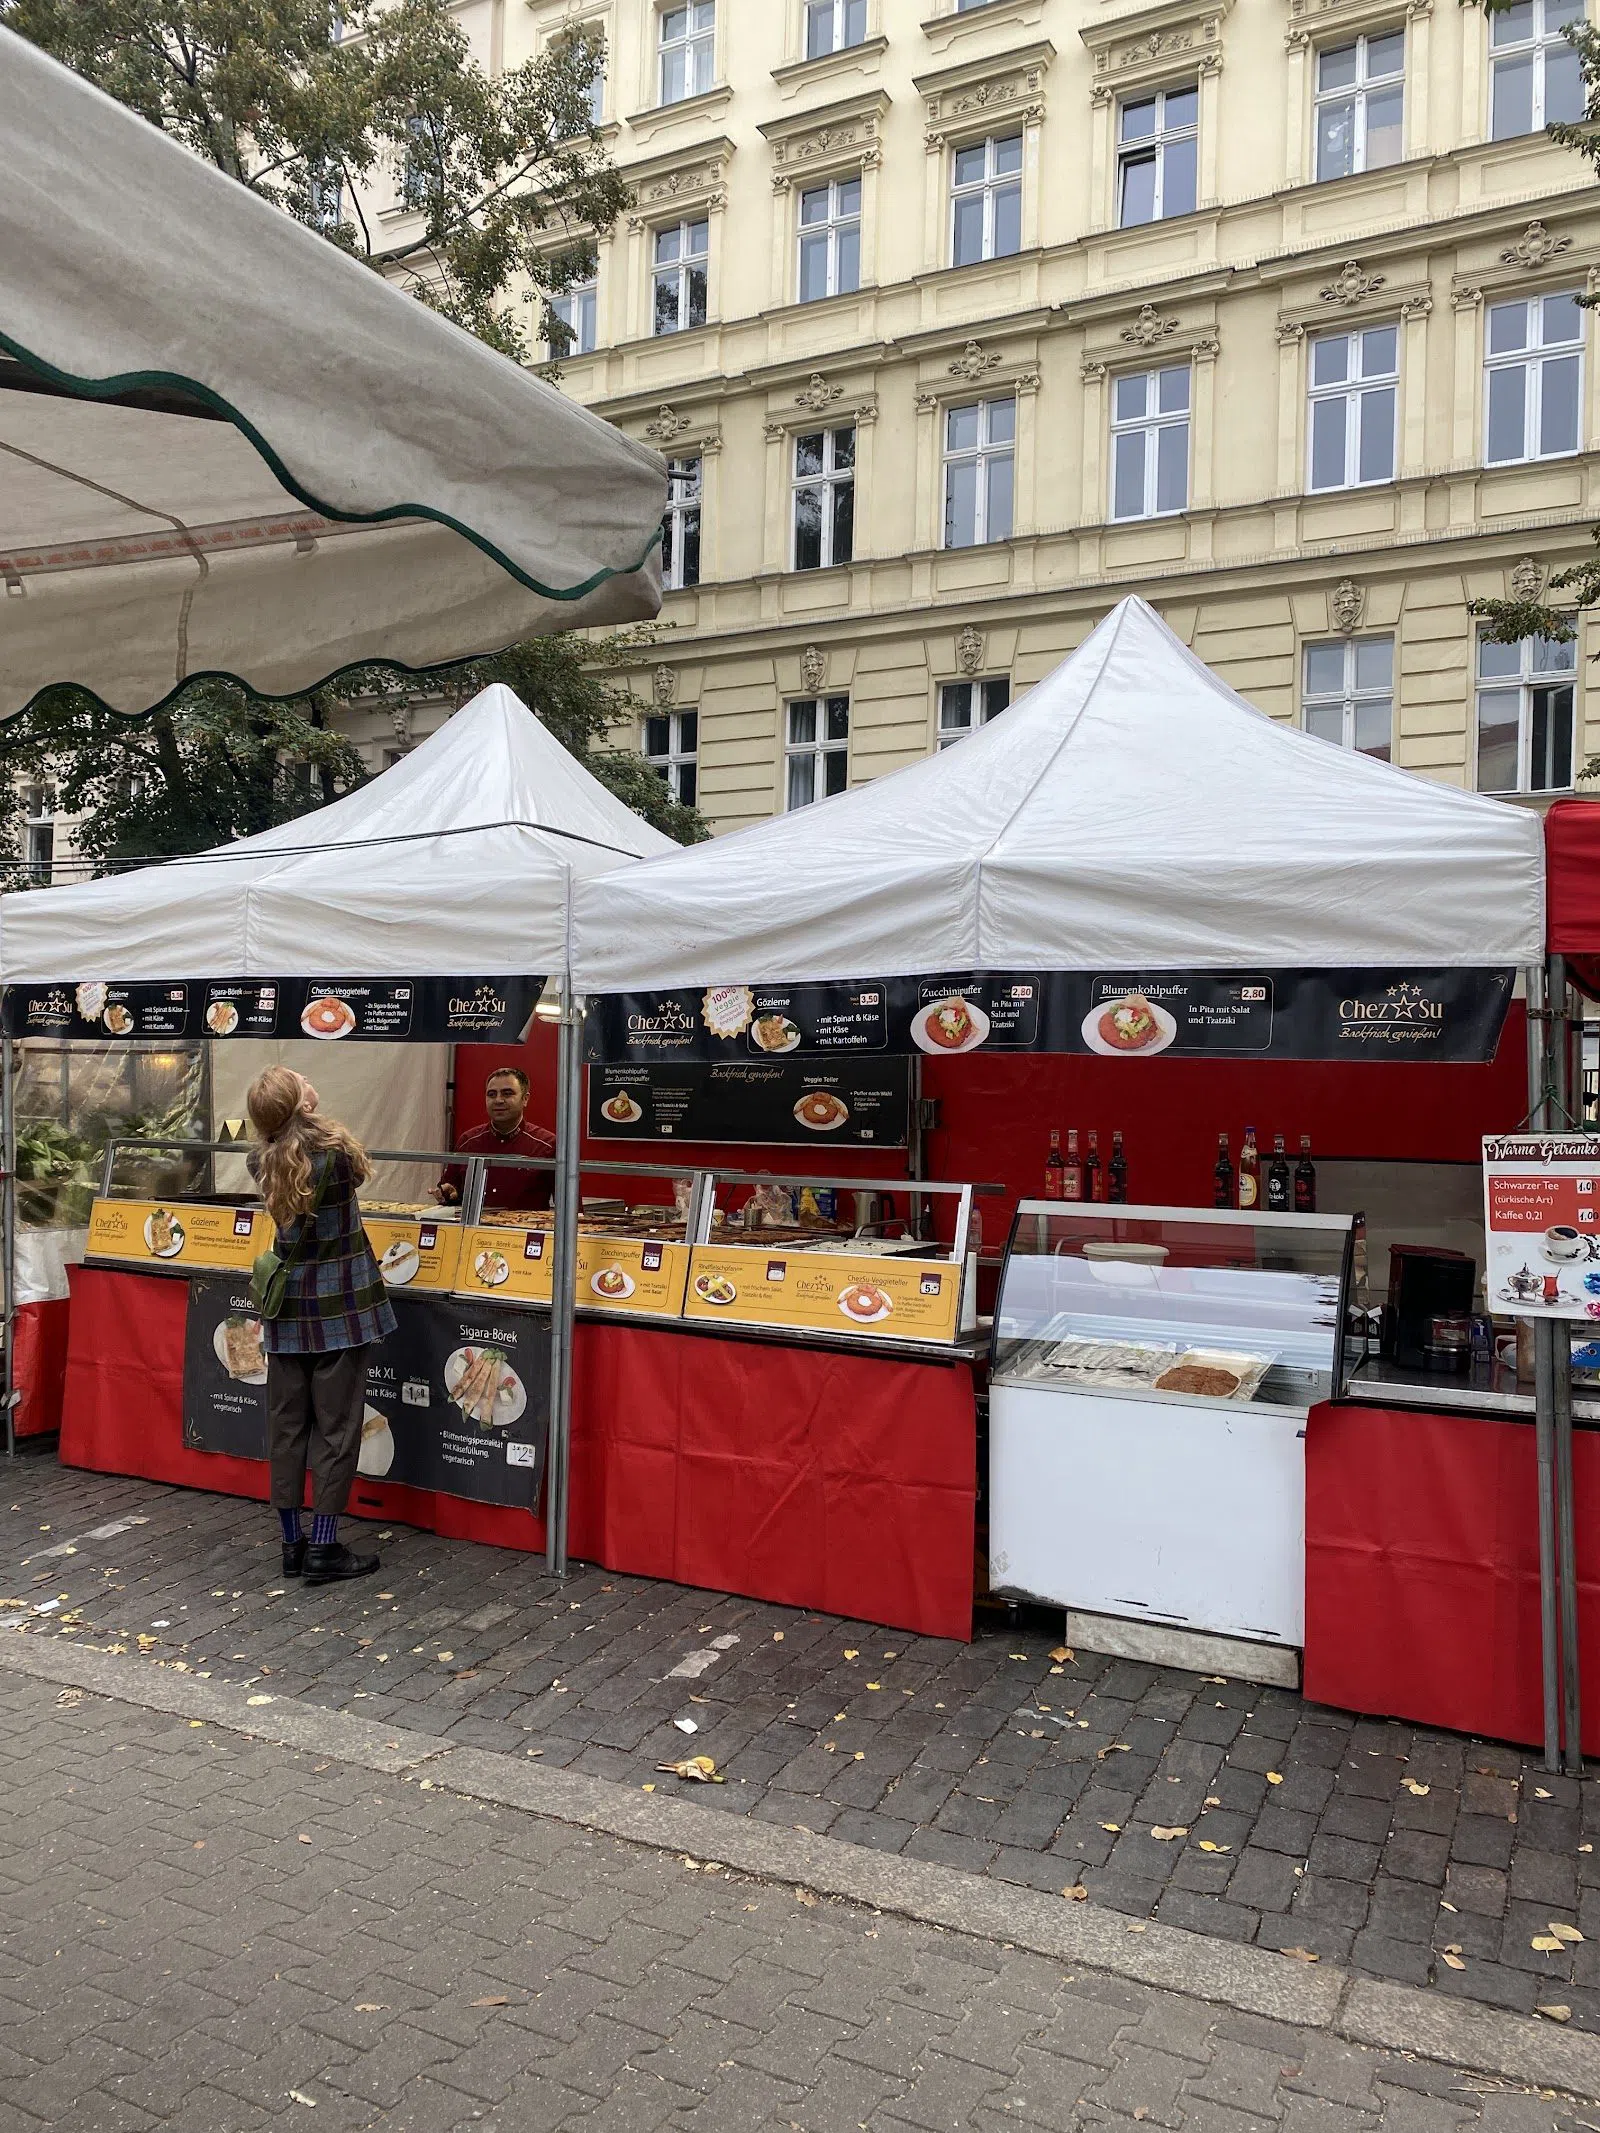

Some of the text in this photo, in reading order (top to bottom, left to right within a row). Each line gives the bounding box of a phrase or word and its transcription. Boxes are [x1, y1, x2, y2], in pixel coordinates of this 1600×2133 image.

[711, 986, 737, 1004] 100%
[921, 984, 982, 997] Zucchinipuffer
[1012, 987, 1031, 997] 2,80
[1101, 984, 1188, 998] Blumenkohlpuffer
[1242, 989, 1264, 998] 2,80
[757, 997, 790, 1006] Gözleme
[862, 994, 878, 1004] 3,50
[29, 1000, 72, 1013] Chez Su
[448, 998, 506, 1013] Chez Su
[1189, 1005, 1250, 1014] In Pita mit Salat
[1339, 999, 1443, 1019] Chez Su
[821, 1013, 879, 1024] mit Spinat & Käse
[991, 1010, 1019, 1018] Salat und
[1188, 1016, 1236, 1024] und Tzatziki
[627, 1013, 694, 1030] Chez Su
[820, 1026, 849, 1034] mit Käse
[1339, 1025, 1390, 1043] Backfrisch
[820, 1035, 867, 1045] mit Kartoffeln
[804, 1076, 822, 1085] Veggie
[1487, 1140, 1599, 1166] Warme Getränke
[1494, 1180, 1560, 1190] Schwarzer Tee
[1495, 1196, 1554, 1205] (türkische Art)
[1495, 1210, 1523, 1219] Kaffee
[95, 1217, 128, 1230] Chez Su
[190, 1216, 220, 1228] Gözleme
[477, 1238, 492, 1247] Sigara
[600, 1248, 641, 1259] Zucchinipuffer
[796, 1280, 834, 1292] Chez Su
[847, 1274, 909, 1287] ChezSu-Veggieteller
[230, 1295, 254, 1309] Gözle
[459, 1324, 518, 1343] Sigara-Börek
[384, 1367, 397, 1380] XL
[223, 1393, 239, 1403] Spinat
[365, 1387, 397, 1399] mit Käse
[213, 1402, 242, 1413] vegetarisch
[443, 1429, 504, 1449] Blätterteigspezialität
[442, 1442, 490, 1458] mit Käsefüllung,
[442, 1453, 475, 1466] vegetarisch
